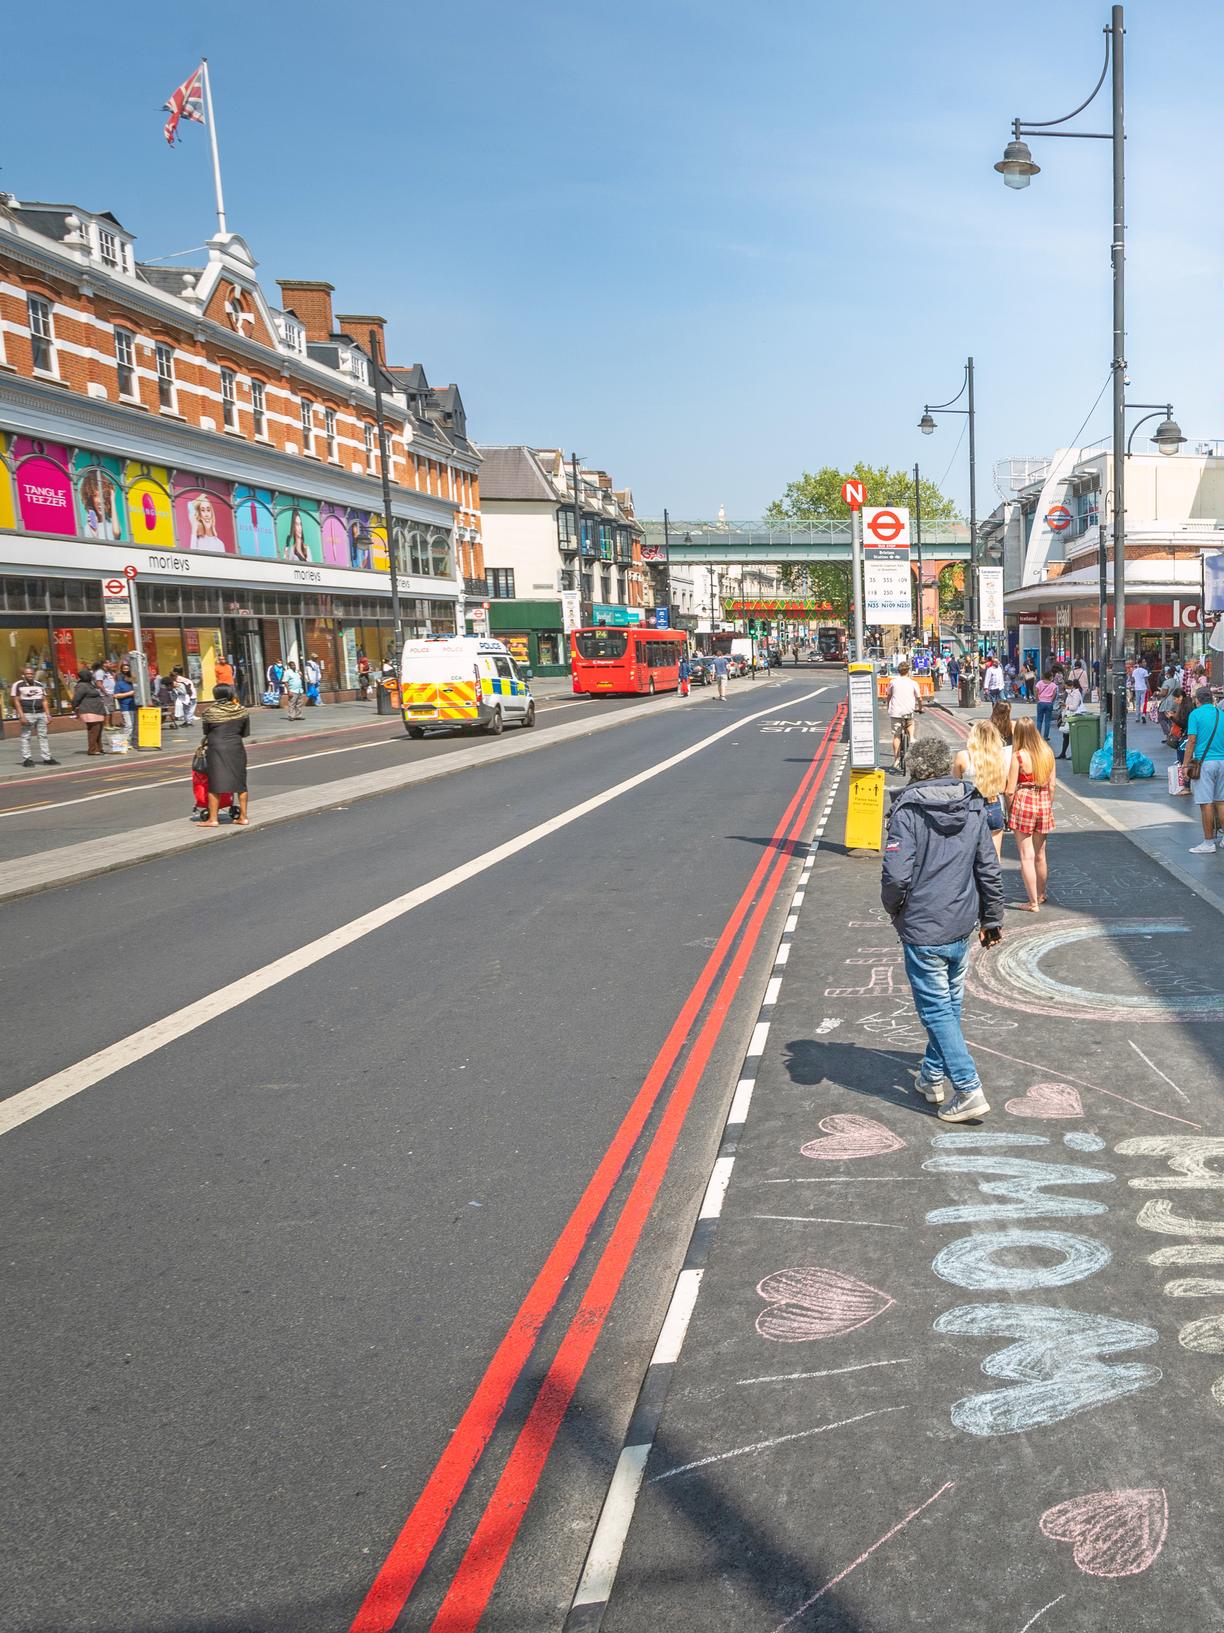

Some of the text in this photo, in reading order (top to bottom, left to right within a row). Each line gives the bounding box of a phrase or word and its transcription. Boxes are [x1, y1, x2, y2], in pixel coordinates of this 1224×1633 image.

[23, 484, 67, 499] TANGLE
[846, 484, 863, 503] N
[25, 494, 67, 507] TEEZER
[148, 555, 190, 572] morleys
[127, 567, 134, 576] S
[294, 570, 321, 582] morleys
[595, 630, 608, 639] P4
[479, 642, 502, 650] POLICE
